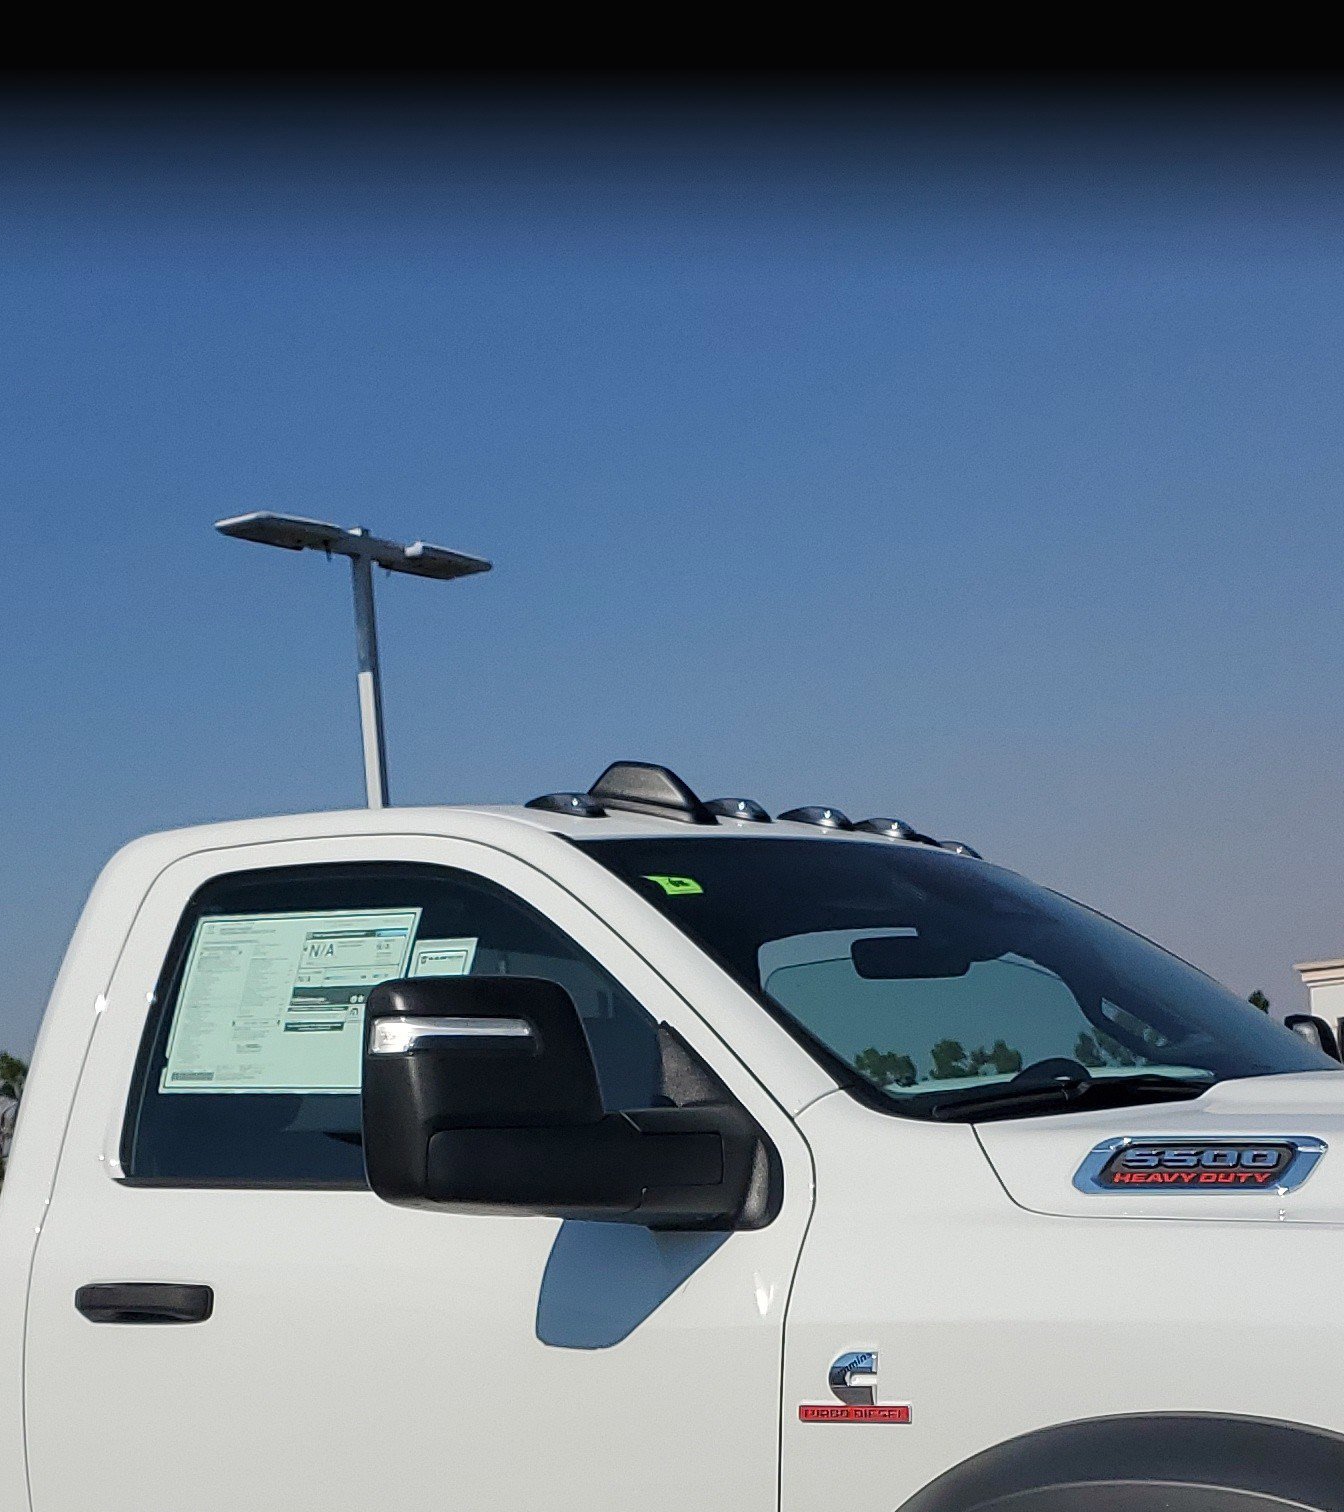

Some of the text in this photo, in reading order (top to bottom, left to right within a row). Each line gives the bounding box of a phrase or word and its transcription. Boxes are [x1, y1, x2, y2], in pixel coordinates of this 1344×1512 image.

[308, 943, 335, 957] N/A
[1123, 1147, 1283, 1170] 5500
[1112, 1172, 1272, 1184] HEAVY DUTY
[803, 1408, 902, 1419] TURBO DIESEL
